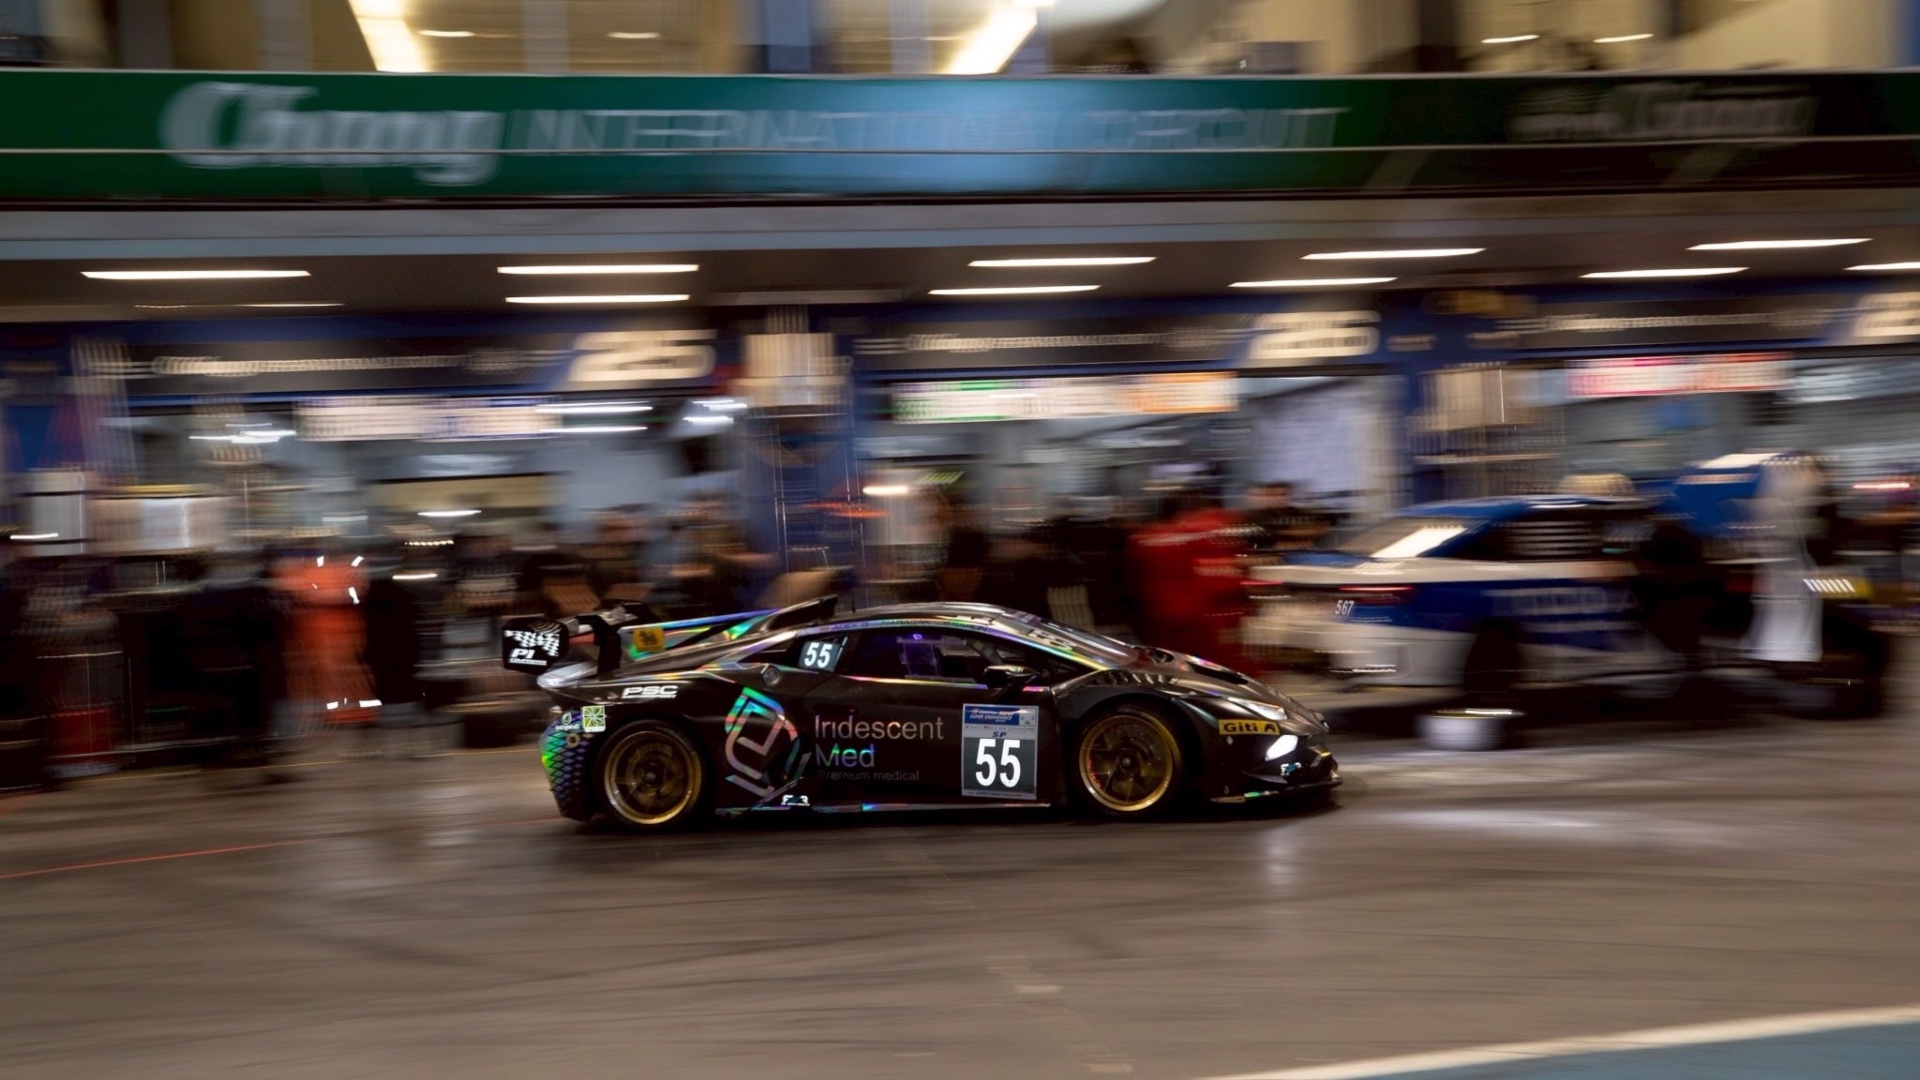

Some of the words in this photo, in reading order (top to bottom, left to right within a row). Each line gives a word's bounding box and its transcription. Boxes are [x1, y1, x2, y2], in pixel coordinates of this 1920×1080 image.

[1335, 599, 1355, 616] 567
[804, 641, 833, 668] 55
[623, 685, 678, 696] PSC
[815, 714, 944, 740] Iridescent
[1223, 722, 1258, 733] Giti
[815, 743, 876, 767] Med
[975, 738, 1021, 788] 55
[873, 769, 920, 781] medical
